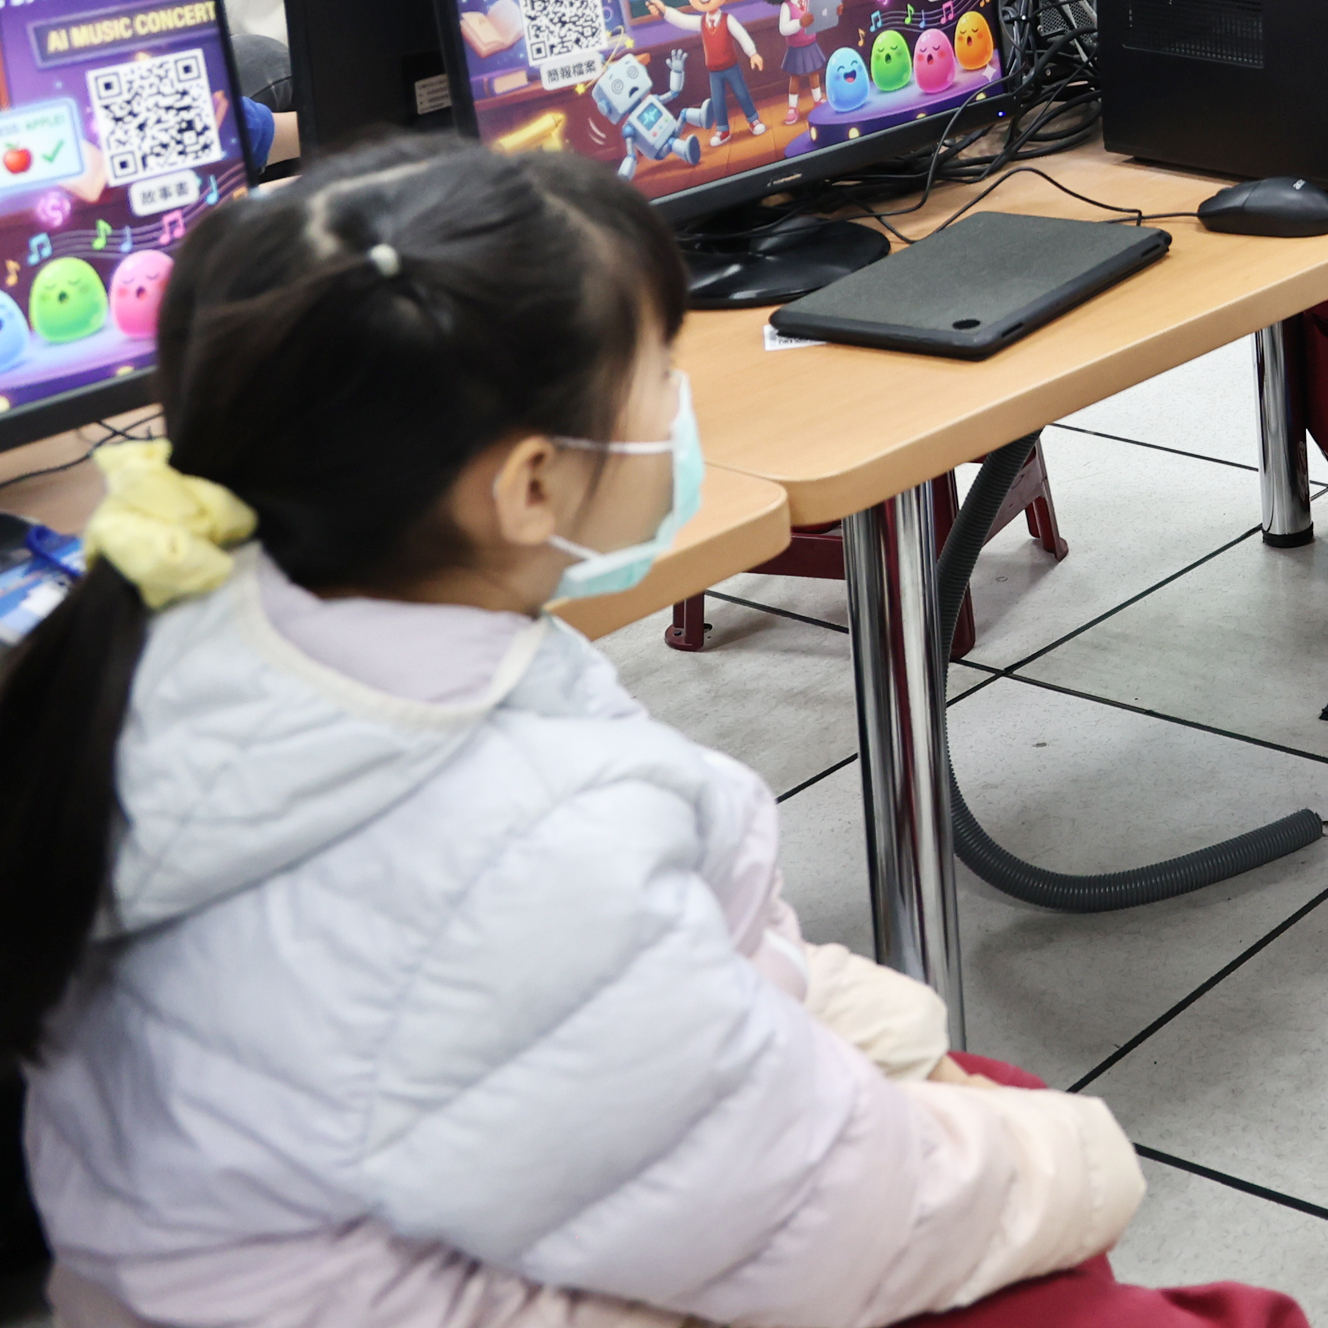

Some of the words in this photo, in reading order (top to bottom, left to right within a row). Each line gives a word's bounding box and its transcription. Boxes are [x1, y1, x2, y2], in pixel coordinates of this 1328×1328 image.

[47, 28, 69, 54] AI
[71, 17, 133, 49] MUSIC
[134, 0, 216, 34] CONCERT
